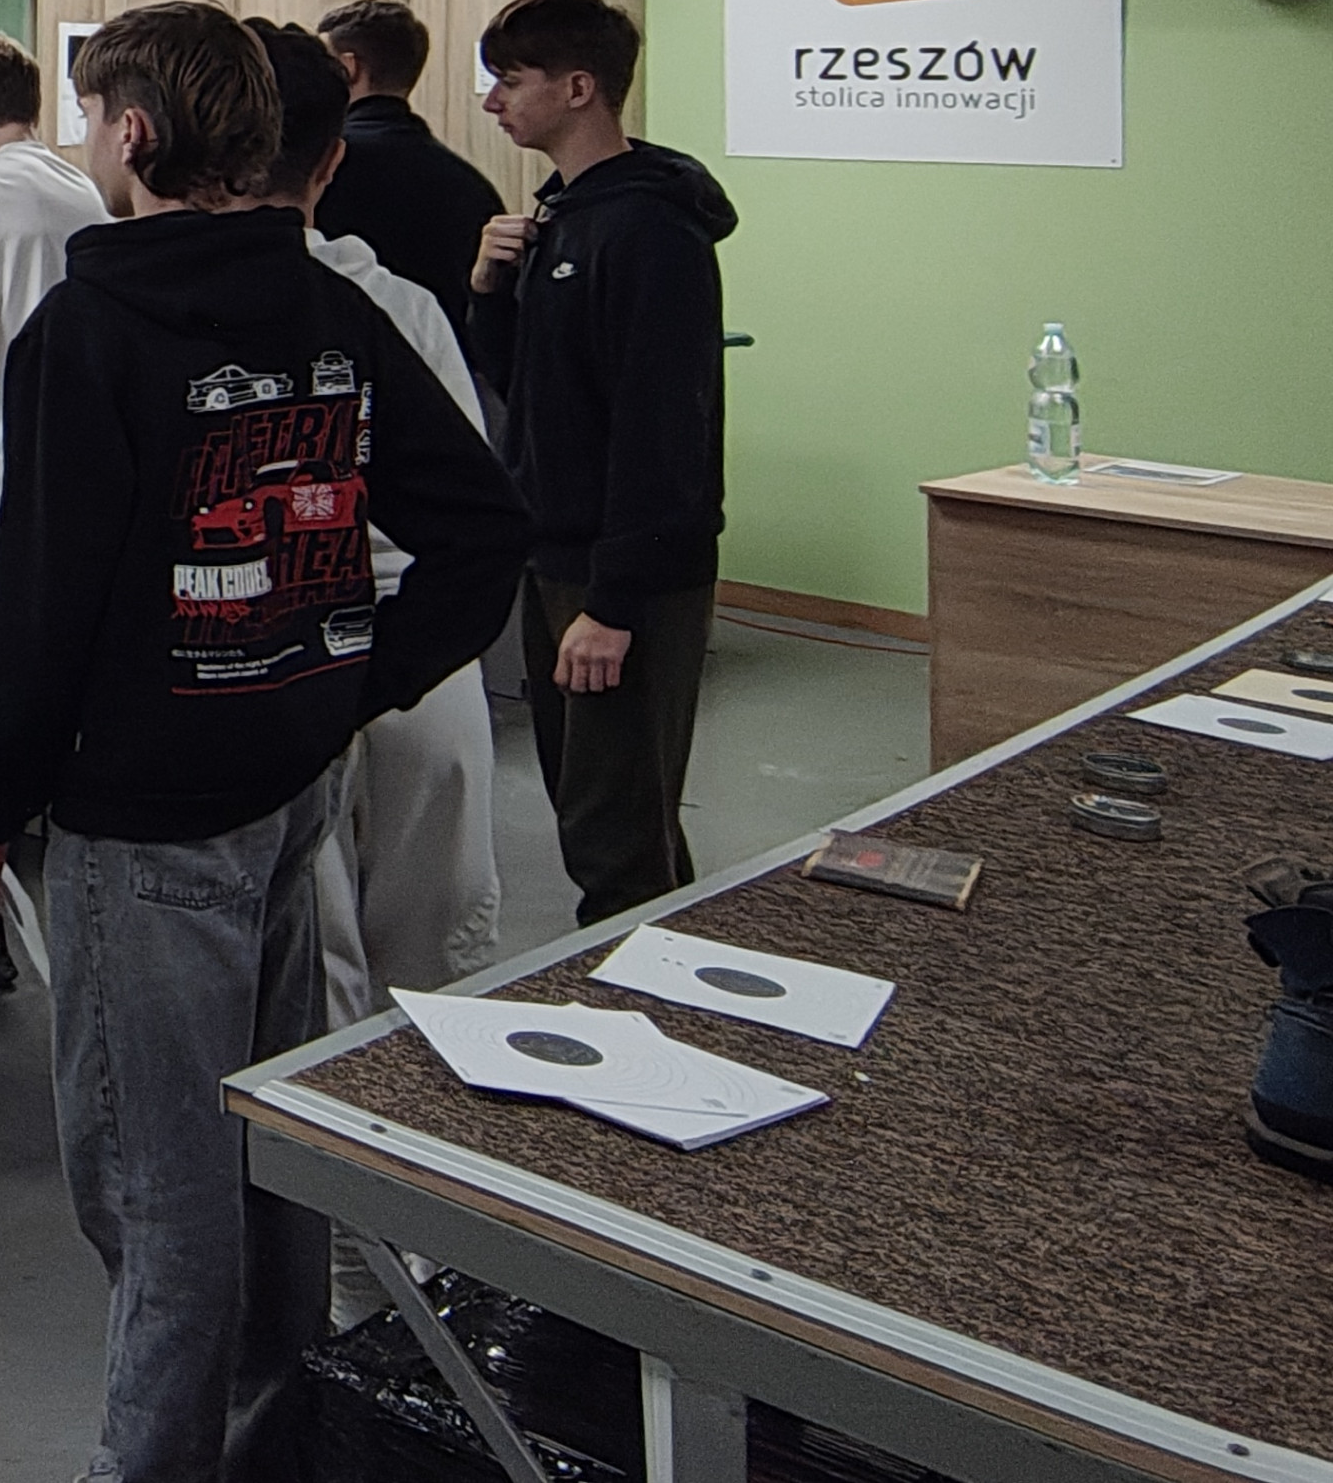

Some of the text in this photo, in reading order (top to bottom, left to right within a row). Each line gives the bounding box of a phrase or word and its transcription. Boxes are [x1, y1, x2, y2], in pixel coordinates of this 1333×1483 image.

[794, 40, 1037, 82] rzeszów
[795, 85, 1036, 120] stolica innowacji
